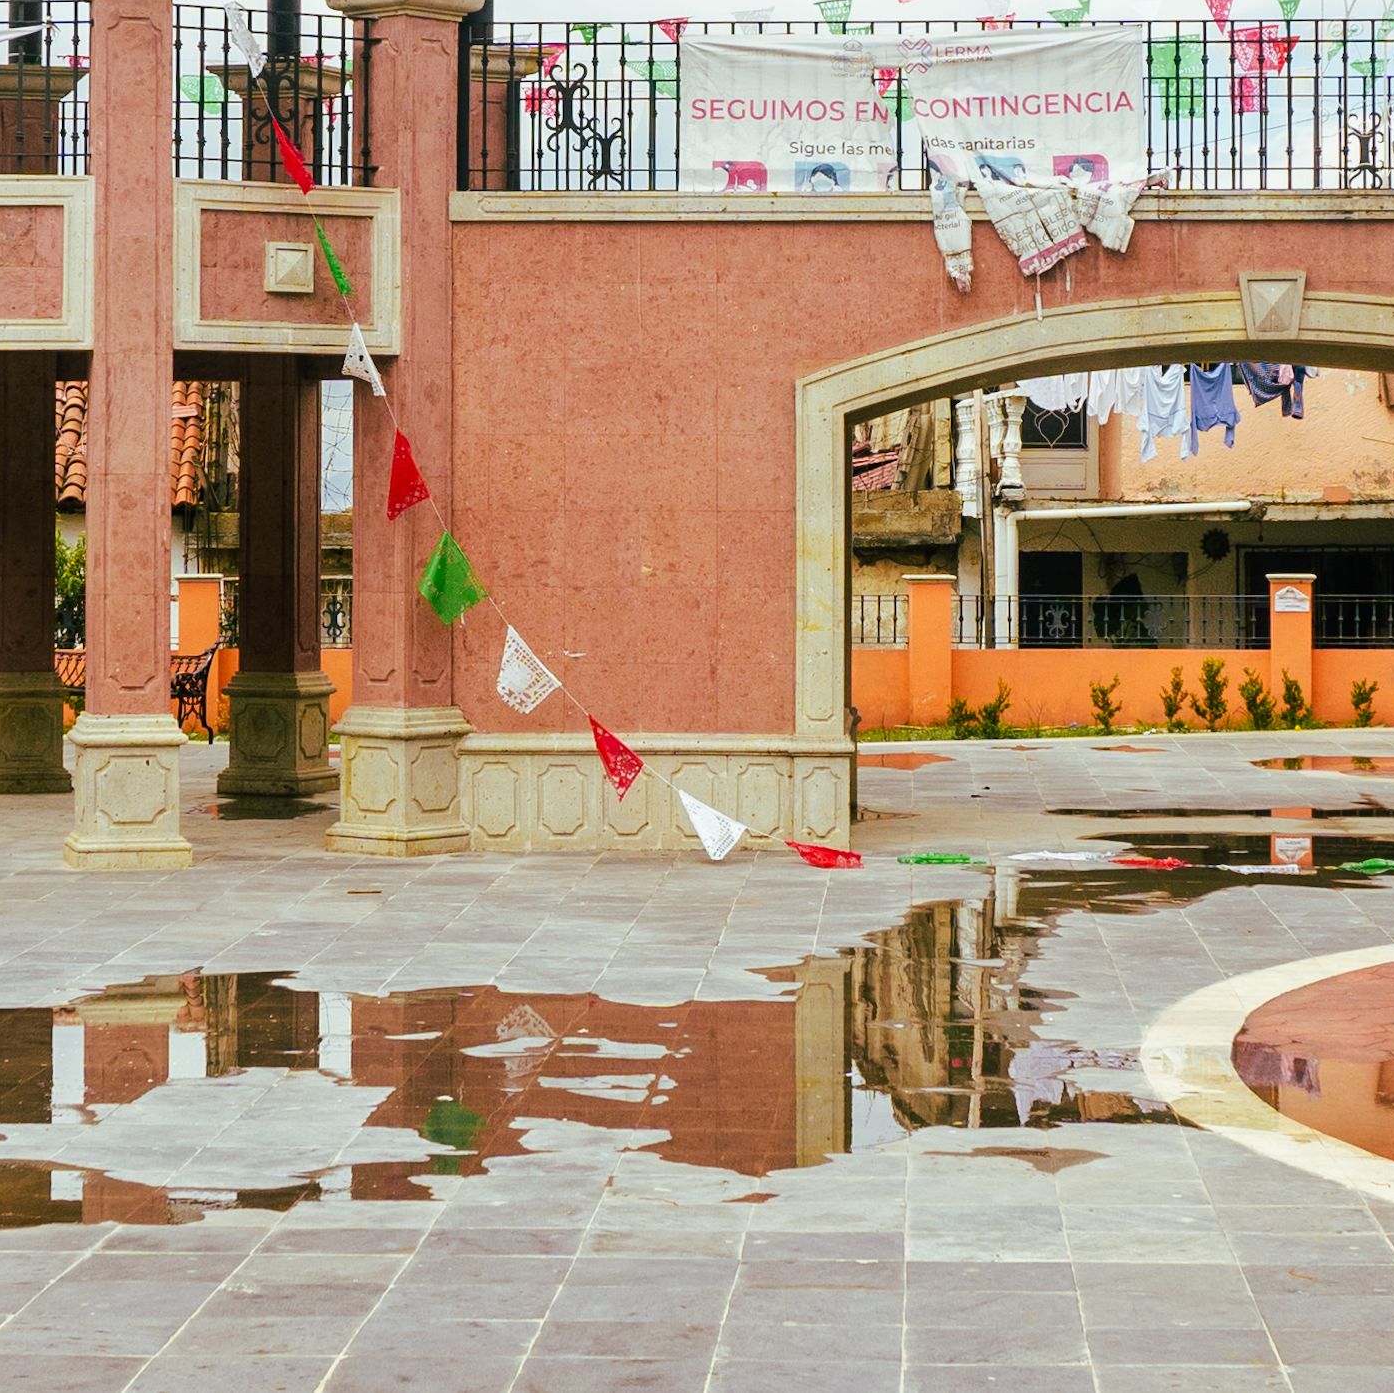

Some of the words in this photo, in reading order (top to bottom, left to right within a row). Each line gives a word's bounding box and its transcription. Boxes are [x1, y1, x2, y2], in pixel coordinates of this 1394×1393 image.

[935, 45, 992, 57] LERMA
[691, 98, 845, 122] SEGUIMOS
[856, 101, 890, 124] EN
[913, 90, 1135, 119] CONTINGENCIA
[789, 141, 836, 157] Sigue
[841, 142, 864, 156] las
[957, 135, 1036, 151] sanitarias
